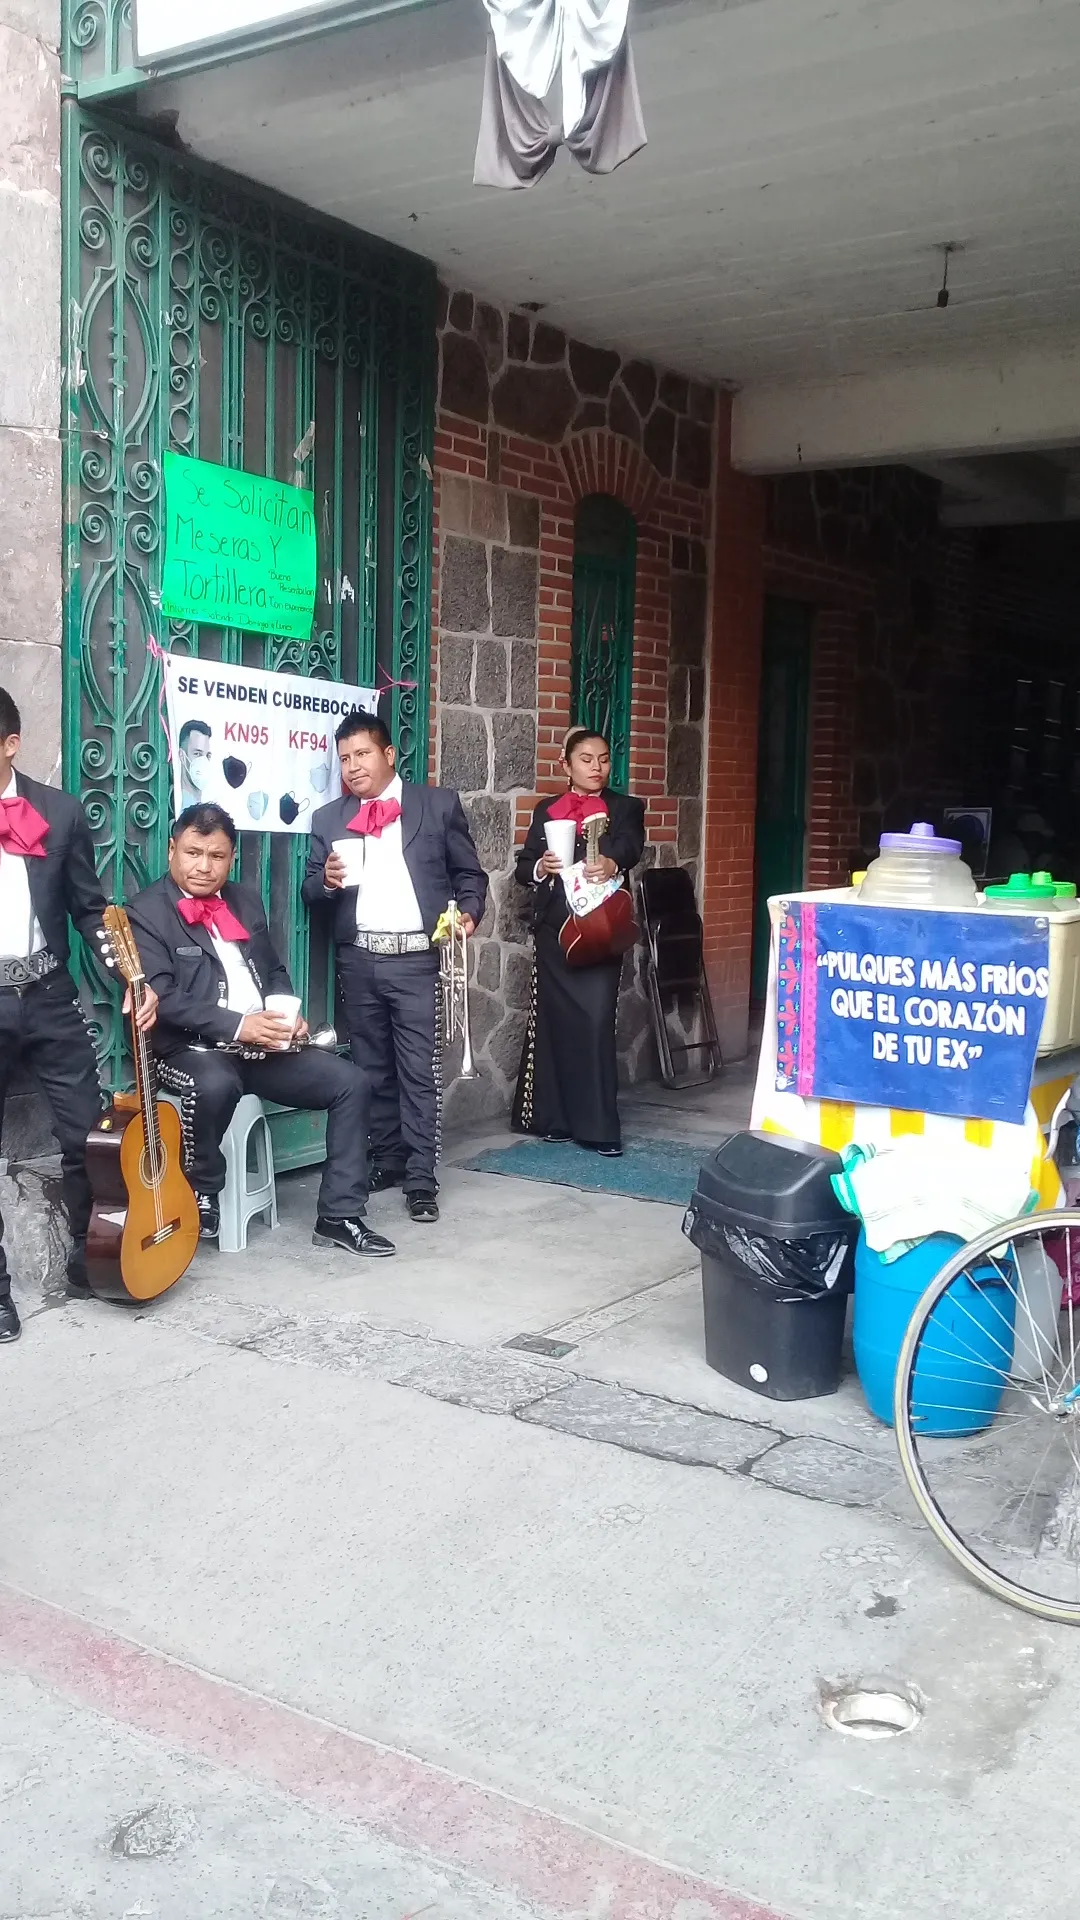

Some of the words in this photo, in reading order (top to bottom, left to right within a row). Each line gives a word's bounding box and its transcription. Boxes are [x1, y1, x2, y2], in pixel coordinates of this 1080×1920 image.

[183, 469, 210, 506] Se
[224, 480, 312, 536] Solicitan
[175, 513, 261, 562] Meseras
[269, 535, 282, 568] Y
[173, 558, 267, 608] Tortillera
[177, 675, 199, 695] SE
[203, 679, 268, 705] VENDEN
[272, 691, 366, 717] CUBREBOCAS
[224, 721, 269, 745] KN95
[288, 730, 328, 752] KF94
[919, 957, 976, 994] MÁS
[981, 960, 1049, 999] FRÍOS
[830, 988, 874, 1021] QUE
[876, 993, 900, 1025] EL
[904, 997, 1025, 1036] CORAZÓN
[872, 1031, 899, 1062] DE
[903, 1034, 932, 1066] TU
